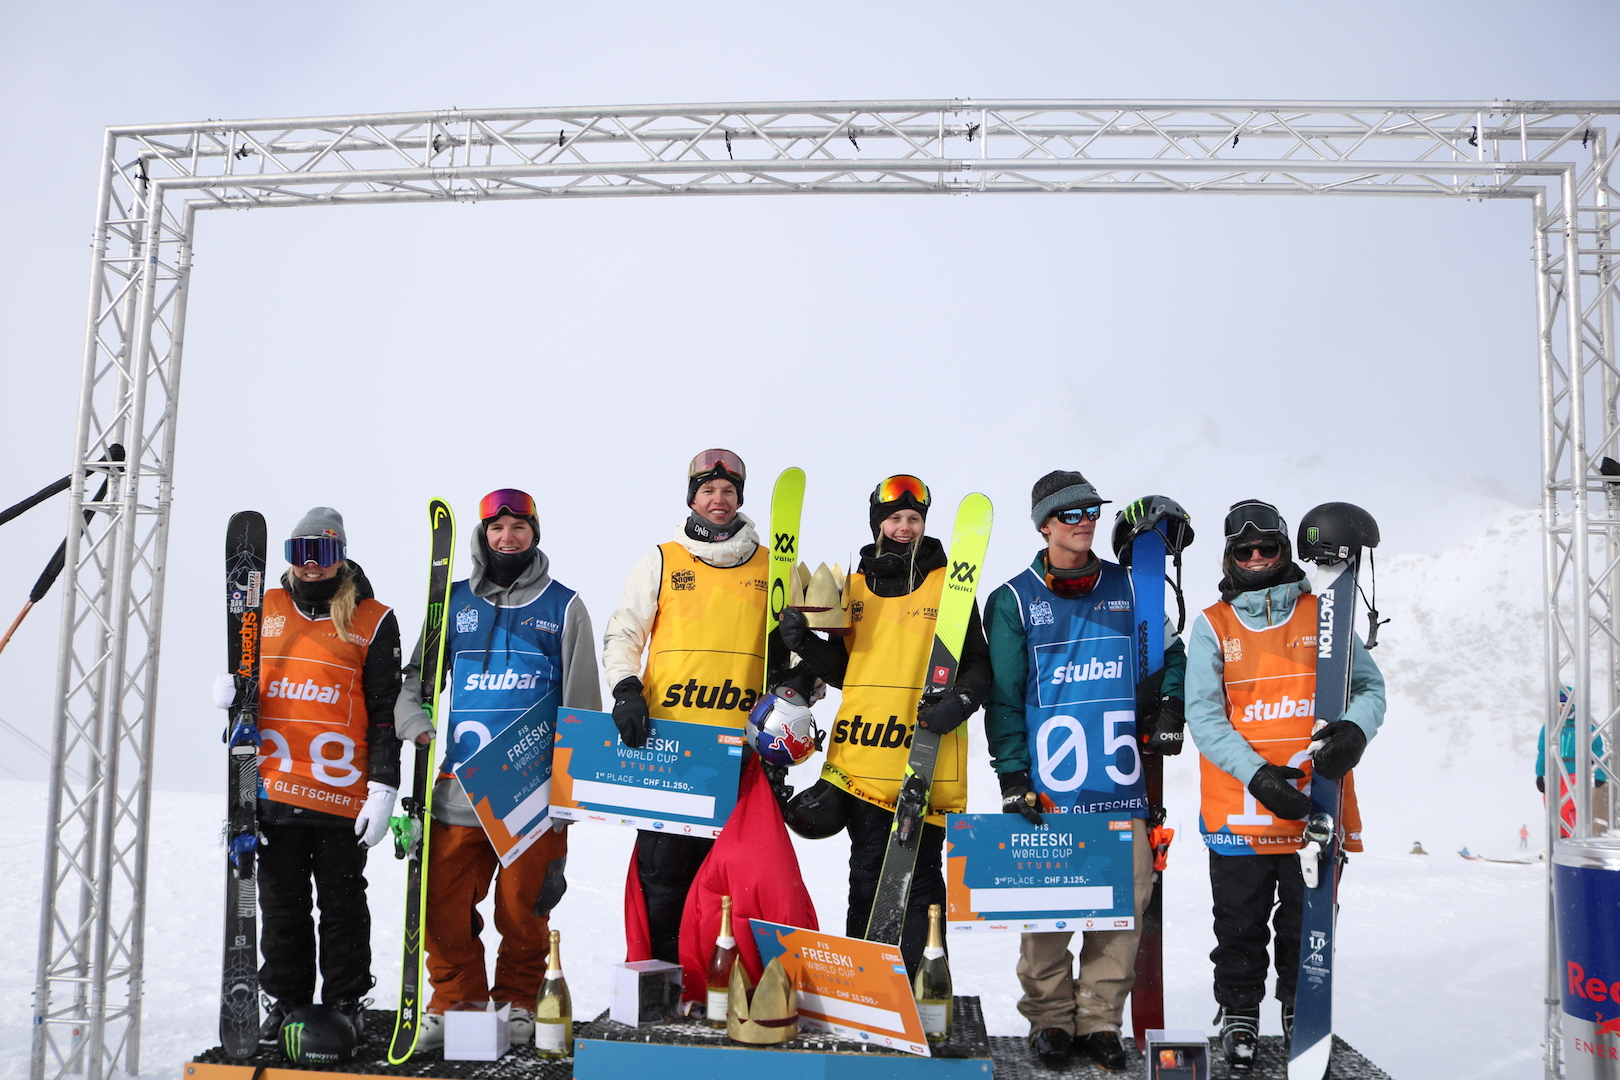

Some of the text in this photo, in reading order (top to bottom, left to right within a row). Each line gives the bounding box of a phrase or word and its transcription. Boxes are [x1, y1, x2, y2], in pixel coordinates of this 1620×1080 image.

[693, 524, 709, 537] DNB
[948, 583, 973, 593] Völkl
[1319, 589, 1335, 658] FACTION
[1051, 655, 1124, 685] stubai
[464, 669, 541, 691] stubai
[267, 677, 341, 704] stubai
[1242, 693, 1316, 722] stubai
[518, 724, 530, 737] FIS
[507, 720, 550, 762] FREESKI
[539, 732, 554, 751] CUP
[617, 734, 679, 753] FESKI
[656, 753, 678, 763] CUP
[620, 761, 672, 773] STUBAI
[522, 774, 542, 795] PLACE
[607, 774, 633, 783] PLACE
[643, 777, 659, 786] CHF
[274, 781, 351, 806] GLETSCHER
[1073, 797, 1143, 814] GLETSCHER
[1011, 833, 1073, 847] FREESKI
[1203, 834, 1253, 845] STUBAIER
[1052, 848, 1073, 858] CUP
[1007, 877, 1034, 885] PLACE
[1044, 876, 1060, 884] CHF
[1063, 876, 1089, 884] 3.125,-
[817, 941, 830, 950] FIS
[1309, 936, 1326, 949] 1.0
[801, 947, 853, 968] FREESKI
[1311, 954, 1323, 962] 170
[837, 965, 856, 978] CUP
[813, 973, 855, 988] STUBAI
[807, 983, 830, 995] PLACE
[836, 990, 850, 999] CHF
